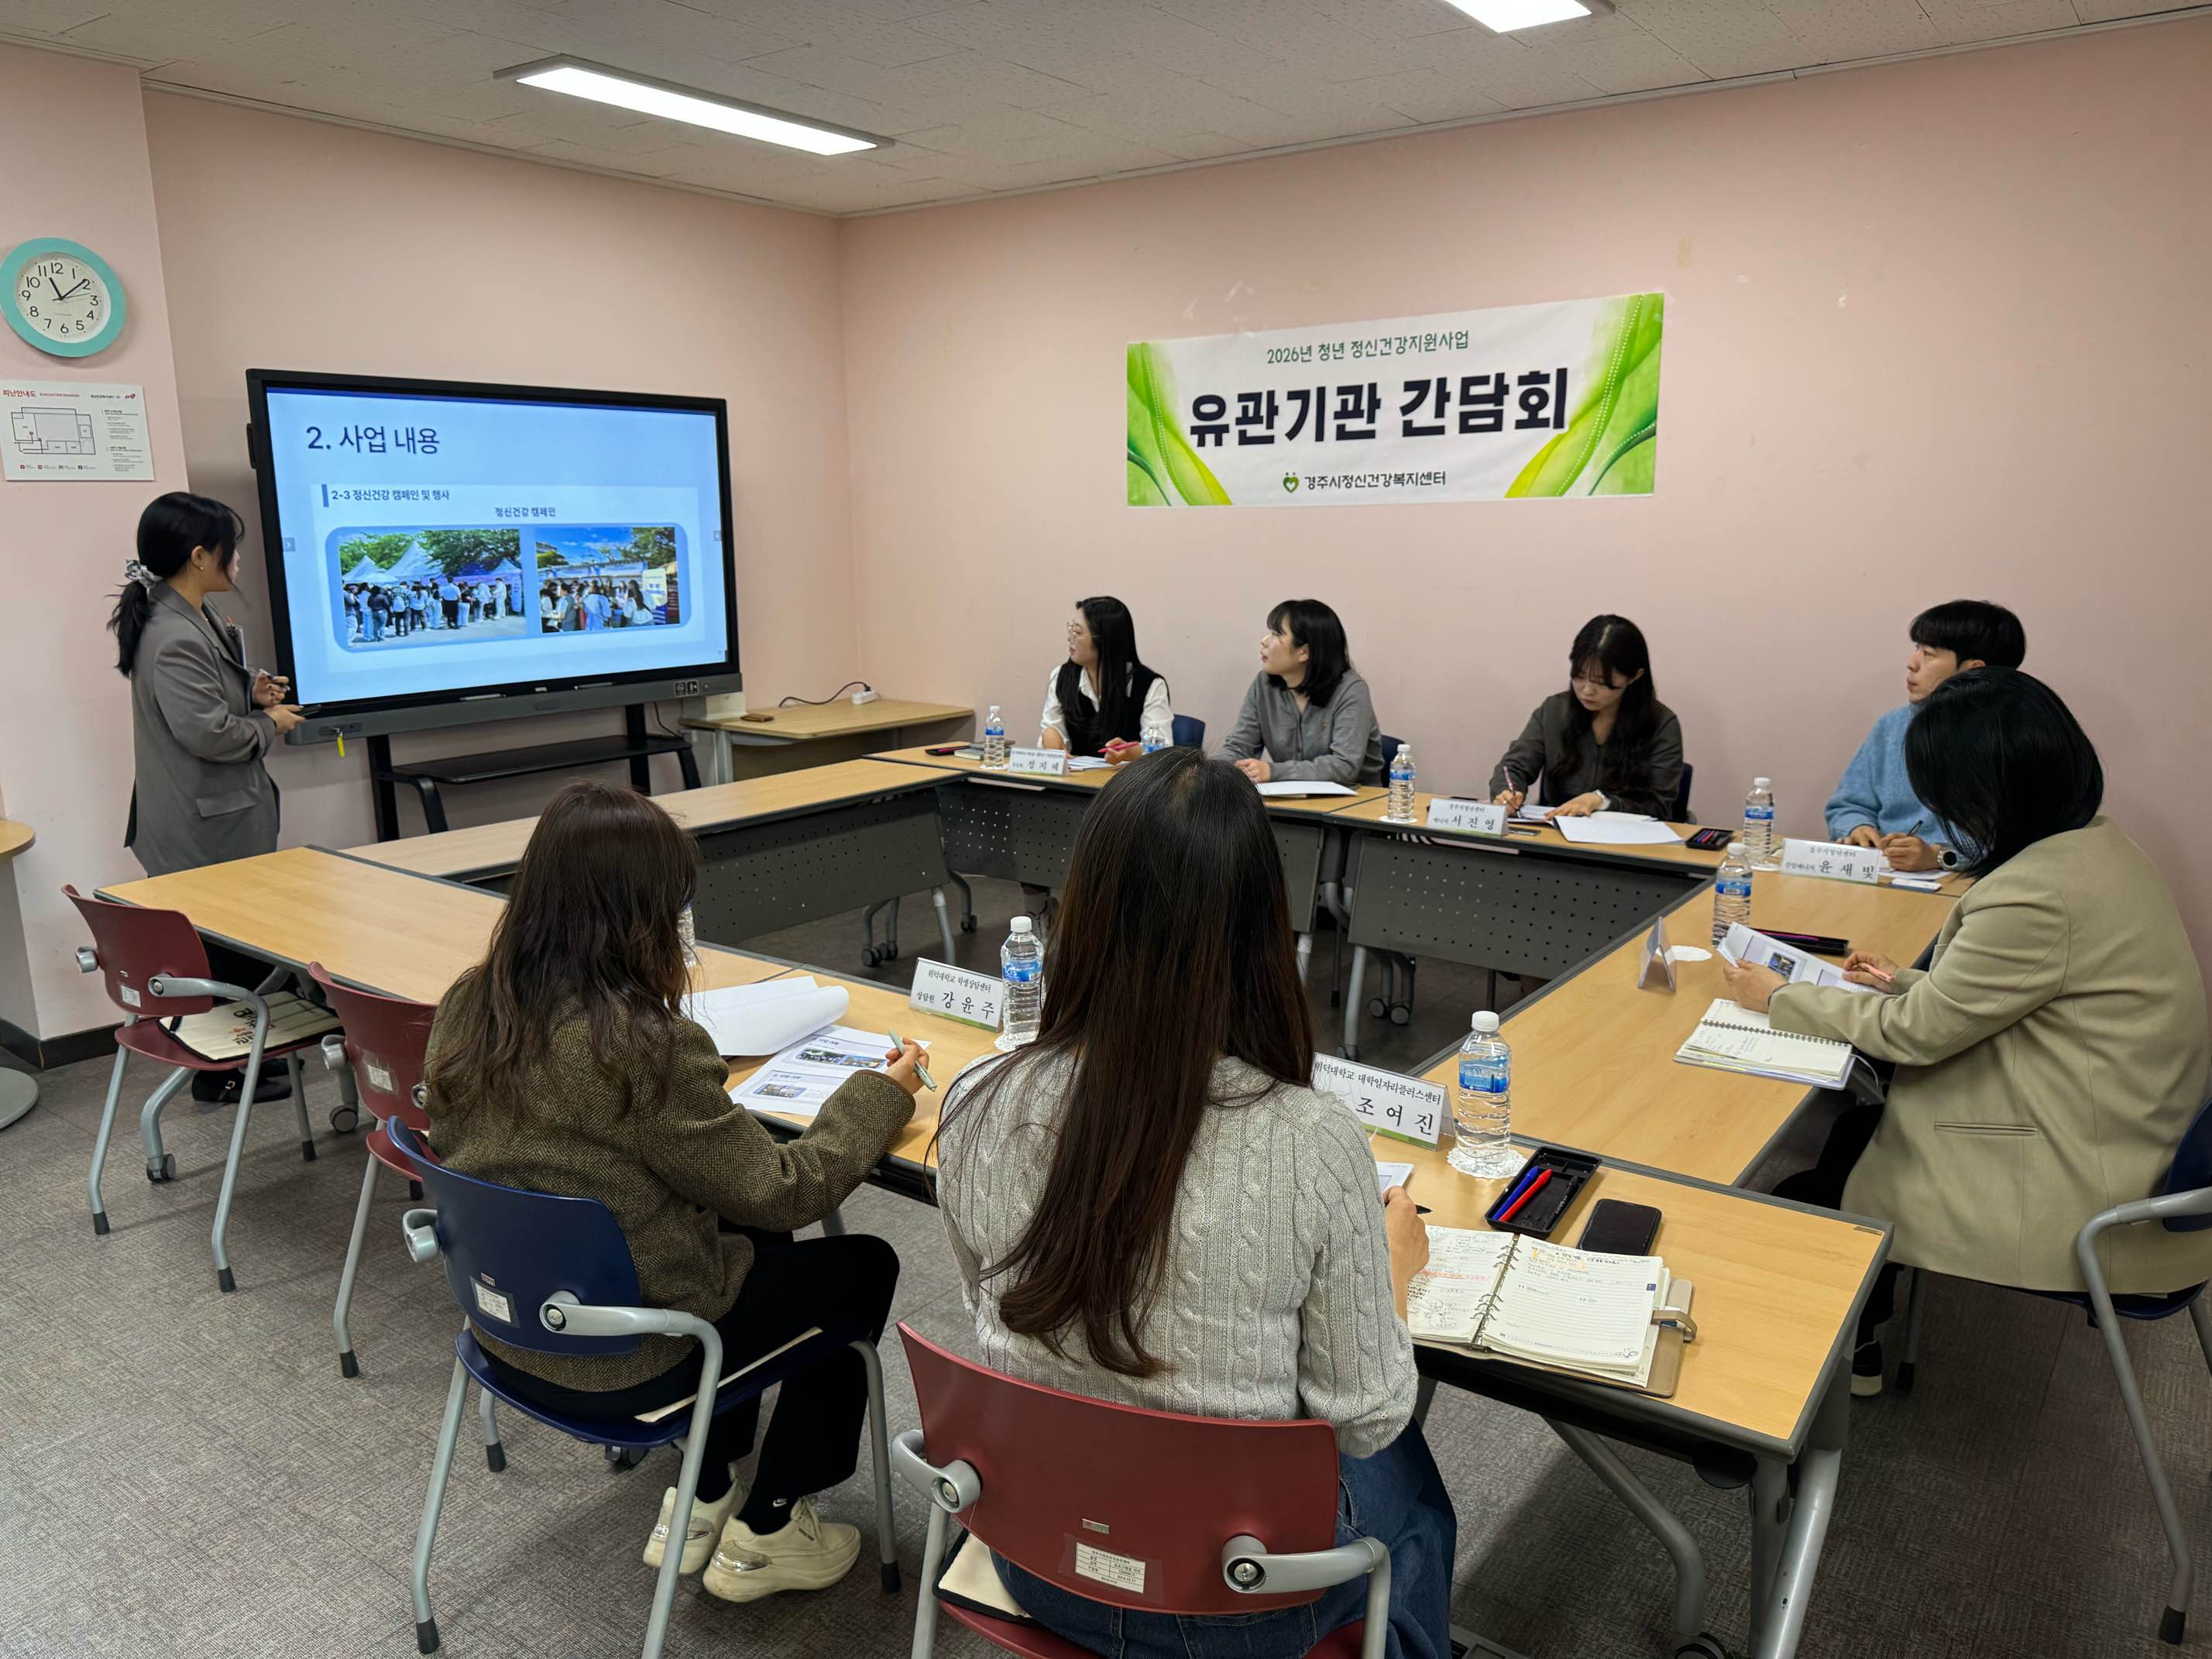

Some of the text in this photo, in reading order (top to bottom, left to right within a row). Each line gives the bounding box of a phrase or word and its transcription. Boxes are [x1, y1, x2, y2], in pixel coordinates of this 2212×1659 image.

[38, 265, 47, 277] 11
[50, 261, 64, 275] 12
[26, 276, 41, 289] 10
[82, 278, 91, 290] 2
[21, 290, 32, 301] 9
[90, 294, 99, 306] 3
[29, 306, 40, 318] 8
[86, 310, 94, 321] 4
[43, 318, 52, 330] 7
[60, 323, 70, 335] 6
[75, 320, 85, 331] 5
[1266, 330, 1469, 365] 2026년 청년 정신건강지원사업
[1190, 367, 1568, 448] 유관기관 간담회
[307, 425, 440, 455] 2. 사업 내용
[1304, 471, 1446, 491] 경주시정신건강복지센터
[331, 489, 450, 501] 2-3 정신건강 캠페인 및 행사
[929, 970, 955, 983] 위덕대학교
[1358, 1074, 1441, 1105] 대학일자리플러스센터
